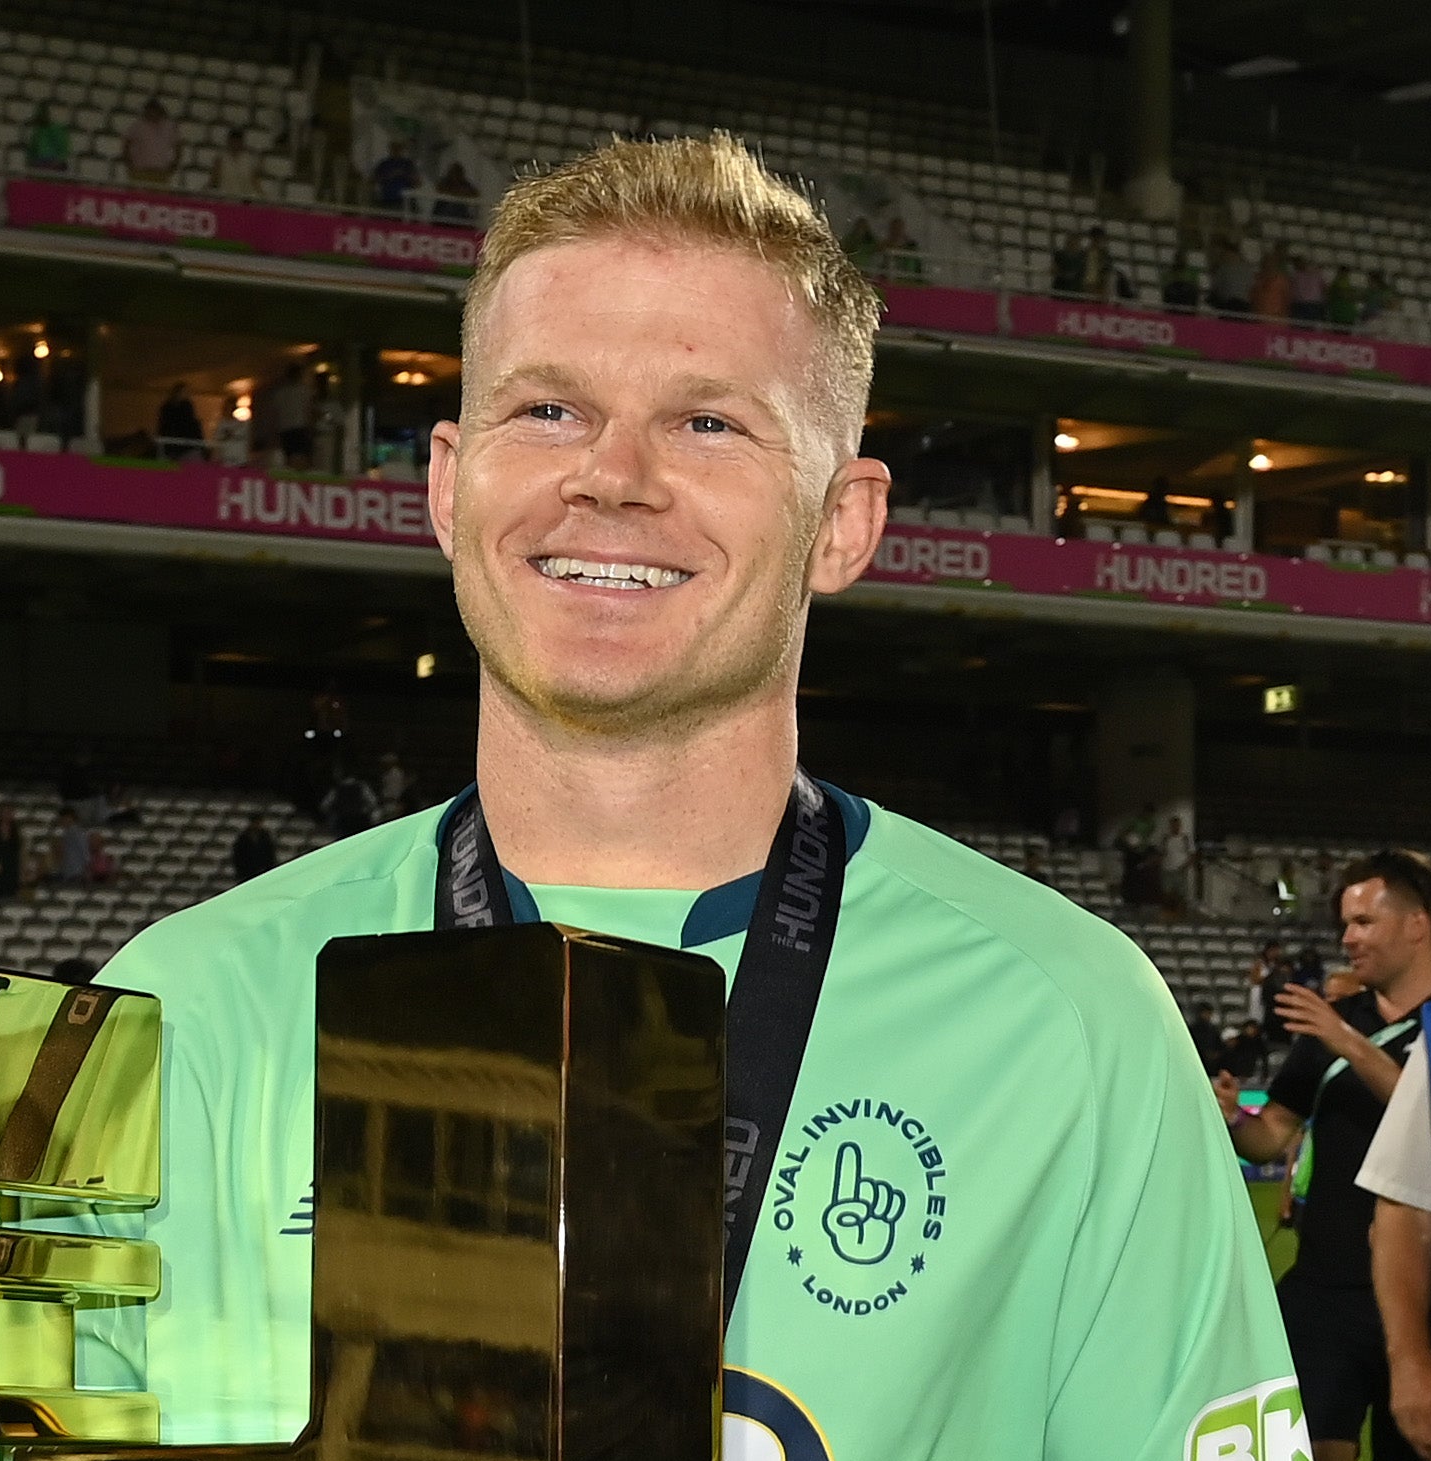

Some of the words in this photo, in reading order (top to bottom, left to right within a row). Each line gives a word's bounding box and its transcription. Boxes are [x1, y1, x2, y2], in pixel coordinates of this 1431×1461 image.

[66, 197, 217, 239] HUNDRED
[333, 225, 477, 266] HUNDRED
[1057, 311, 1175, 346] HUNDRED
[1267, 335, 1376, 369] HUNDRED
[217, 477, 436, 536] HUNDRE
[1096, 552, 1267, 601] HUNDRED
[773, 1145, 811, 1231] OVAL
[801, 1098, 947, 1241] INVINCIBLES
[801, 1273, 908, 1316] LONDON
